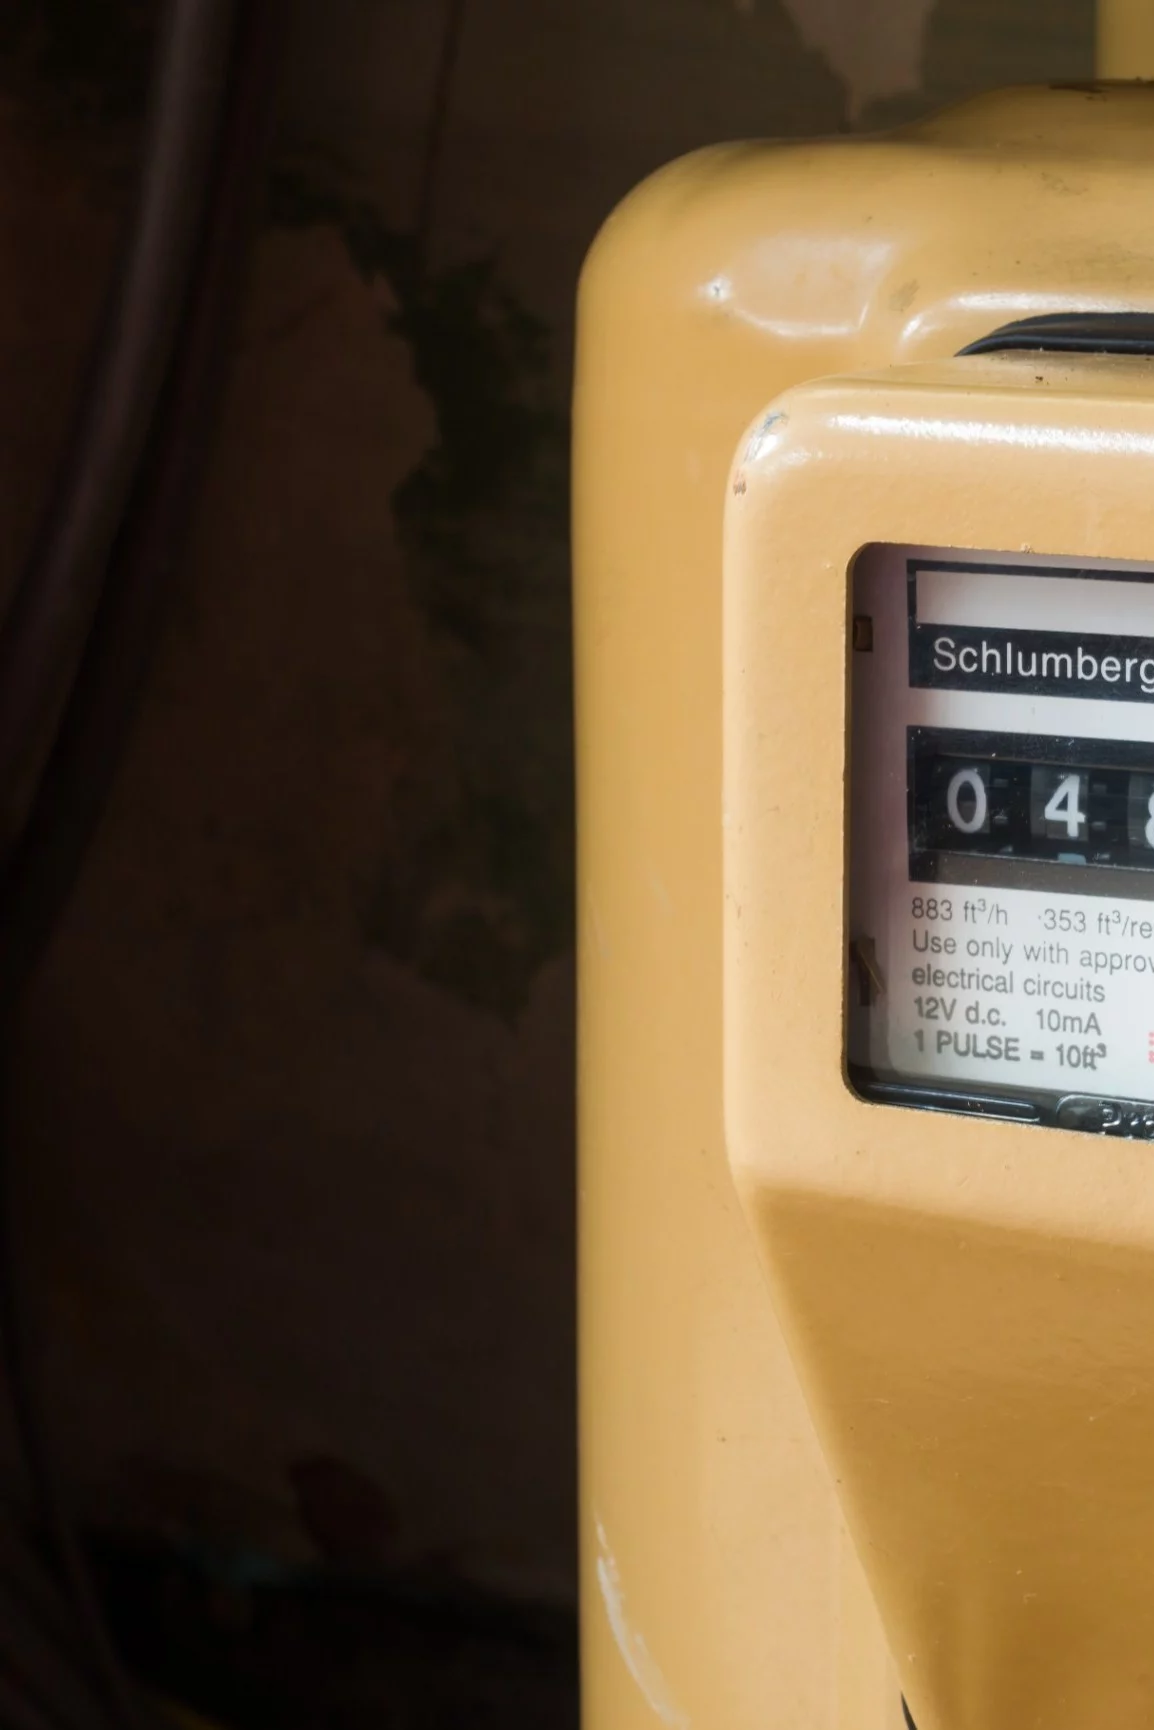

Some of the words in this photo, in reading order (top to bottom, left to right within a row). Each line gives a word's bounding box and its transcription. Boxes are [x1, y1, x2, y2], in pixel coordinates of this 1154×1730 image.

[911, 896, 953, 921] 883
[912, 929, 957, 955] Use
[966, 936, 1013, 965] only
[1023, 941, 1069, 966] with
[911, 963, 1014, 994] electrical
[1023, 973, 1106, 1003] circuits
[913, 996, 957, 1021] 12V
[965, 1001, 1007, 1027] d.c.
[1035, 1007, 1102, 1036] 10mA
[913, 1029, 925, 1053] 1
[936, 1030, 1021, 1062] PULSE
